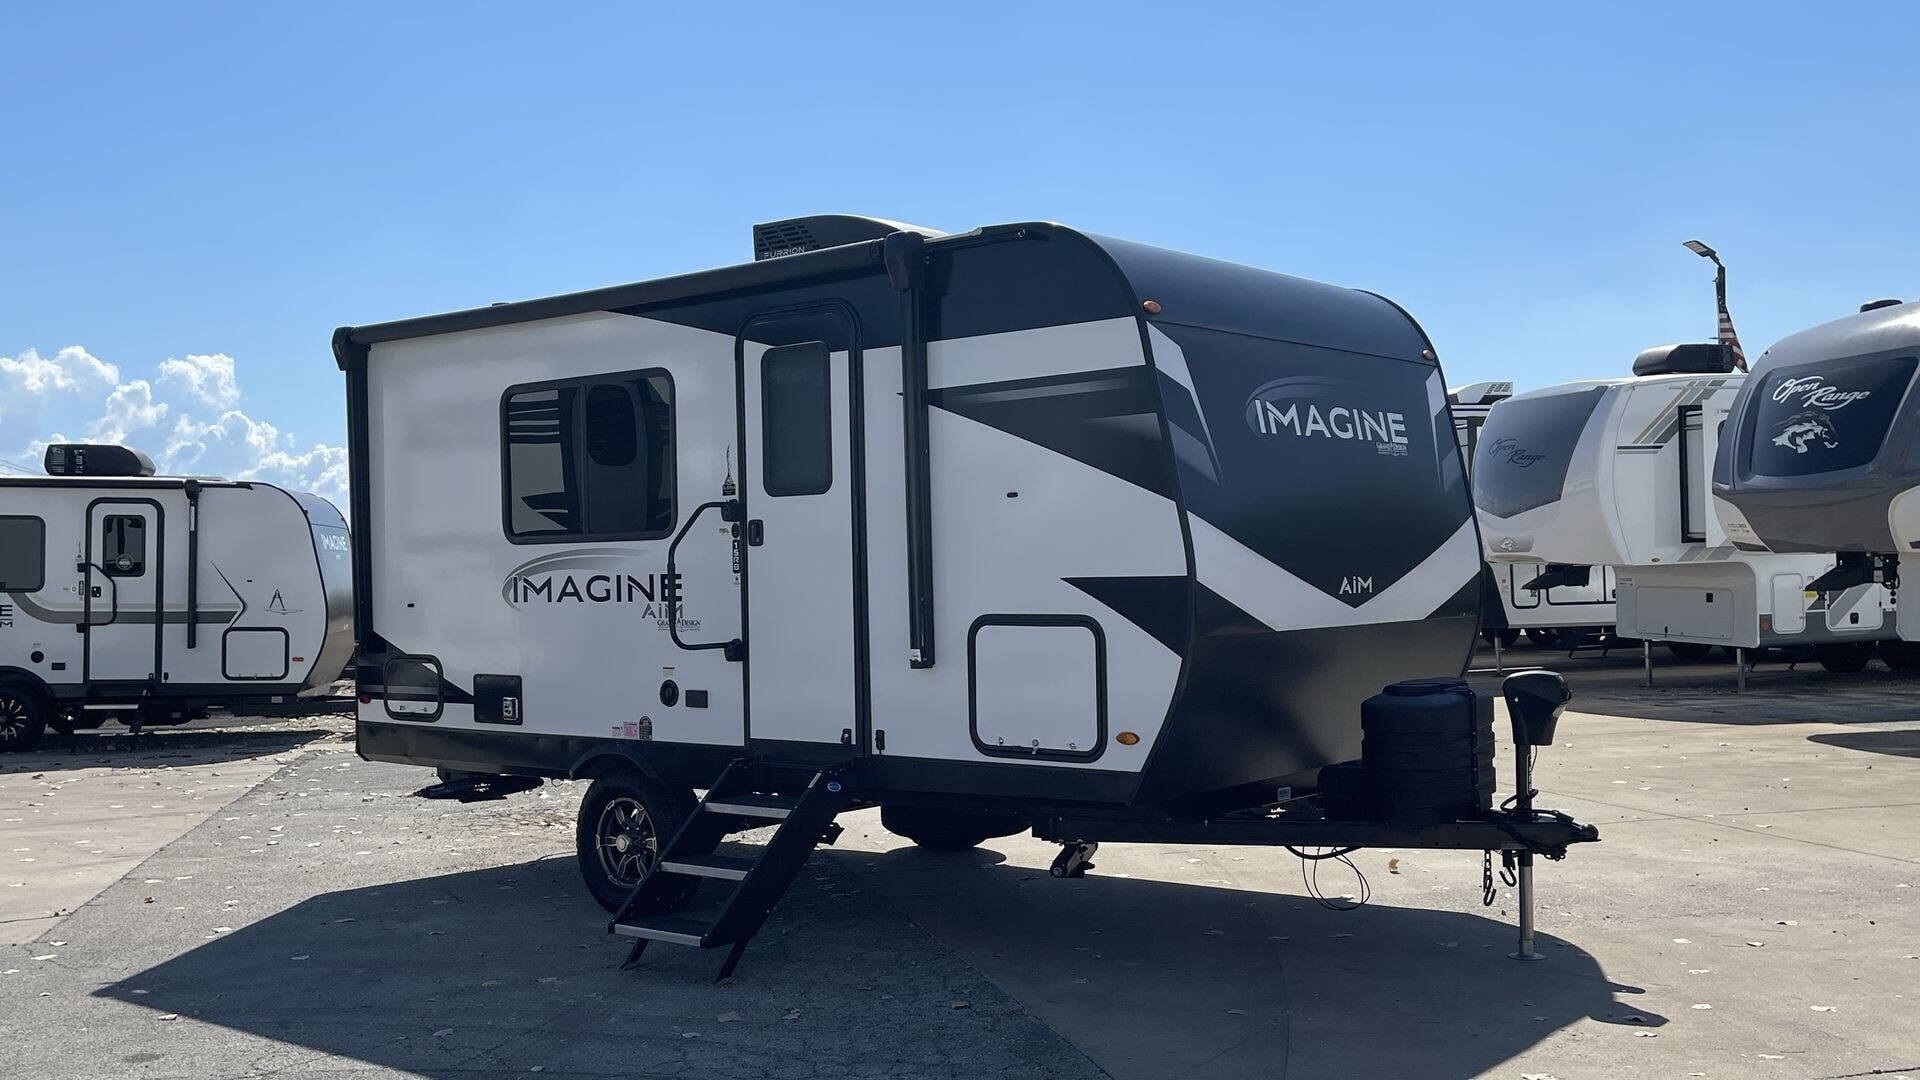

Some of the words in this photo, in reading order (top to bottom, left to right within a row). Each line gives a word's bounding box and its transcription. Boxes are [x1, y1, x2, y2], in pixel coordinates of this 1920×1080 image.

[763, 246, 806, 260] FURRION
[1772, 375, 1824, 405] Open
[1800, 386, 1871, 411] Range
[1254, 399, 1409, 444] IMAGINE
[512, 573, 683, 603] IMAGINE
